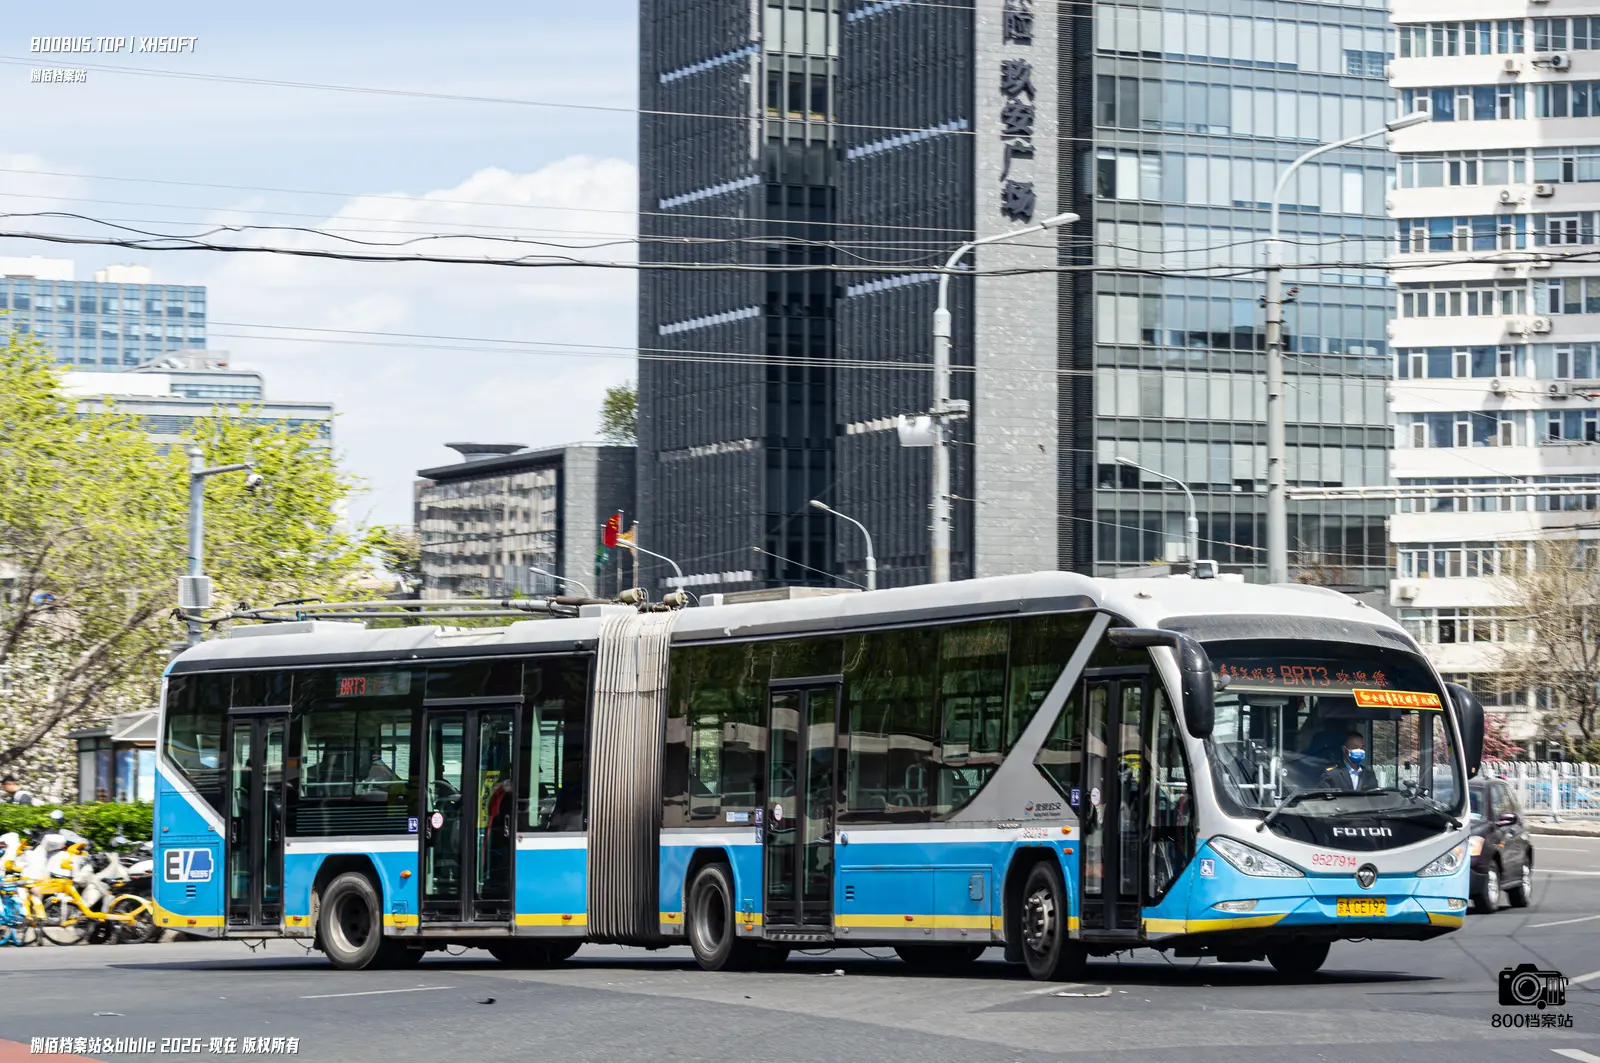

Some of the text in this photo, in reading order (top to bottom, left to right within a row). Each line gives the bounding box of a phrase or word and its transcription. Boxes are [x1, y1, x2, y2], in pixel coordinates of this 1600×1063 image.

[1000, 58, 1037, 224] 玖安广场
[1280, 665, 1331, 687] BRT3
[1335, 668, 1389, 688] 欢迎您
[340, 677, 366, 695] BRT3
[1332, 827, 1393, 837] FOTON
[1311, 853, 1357, 868] 9527914
